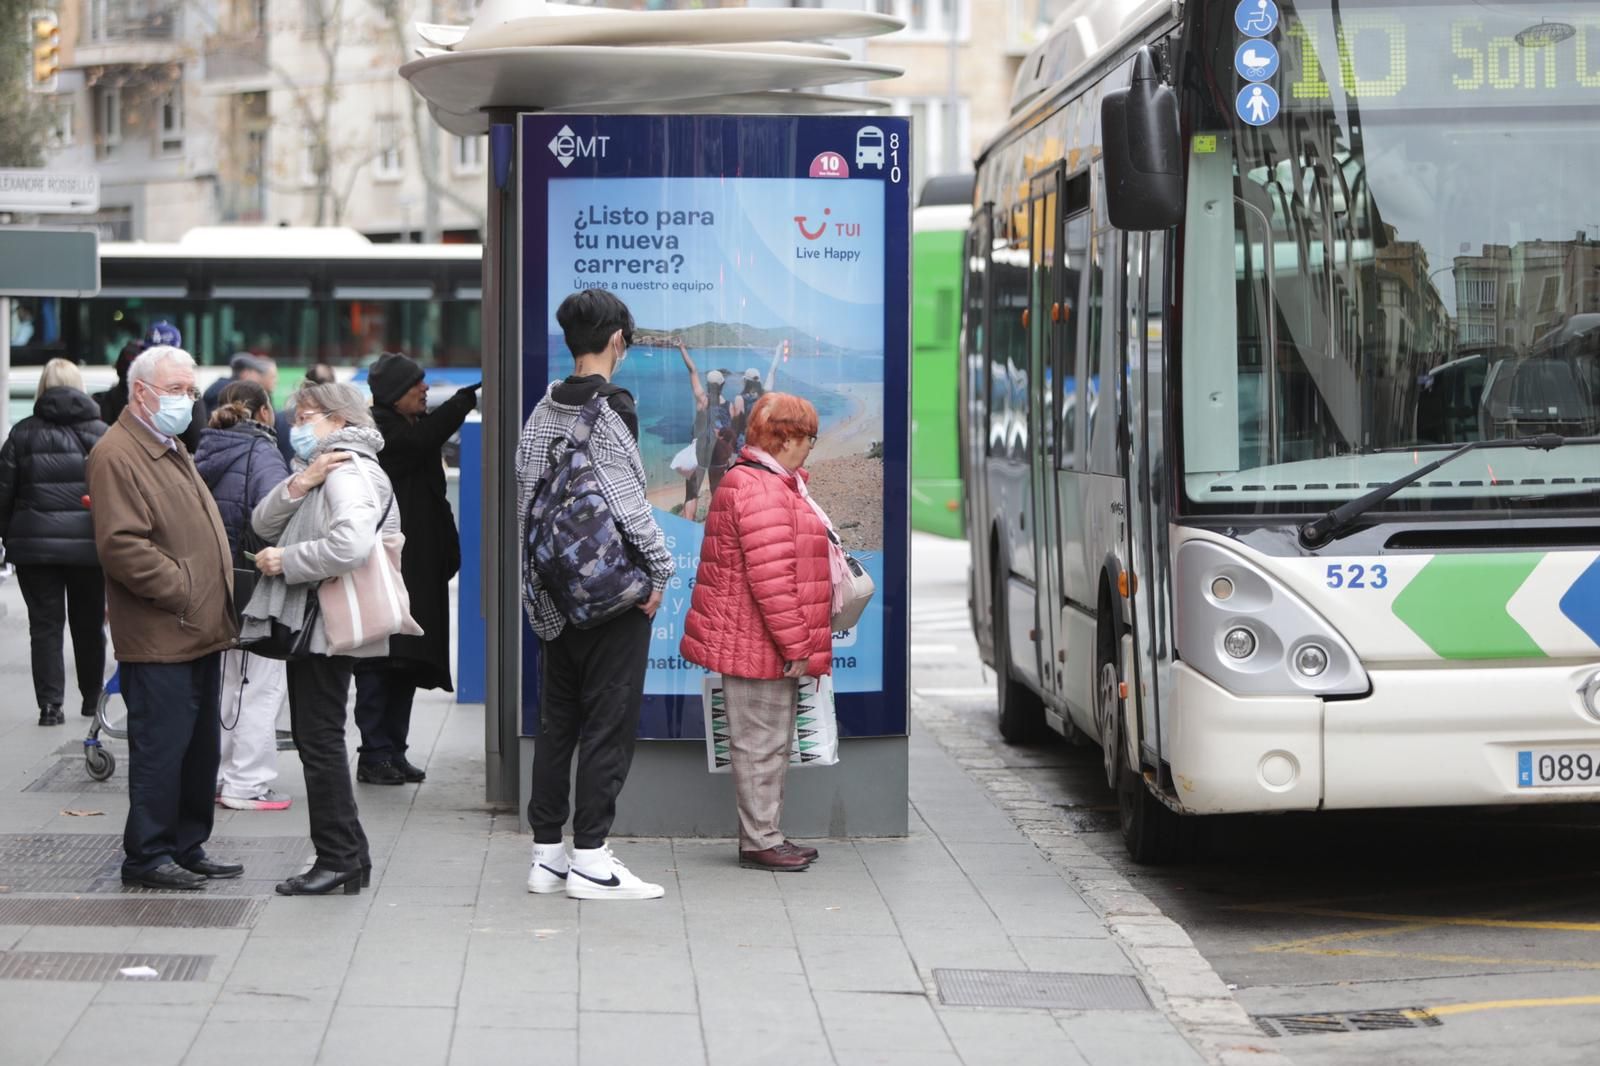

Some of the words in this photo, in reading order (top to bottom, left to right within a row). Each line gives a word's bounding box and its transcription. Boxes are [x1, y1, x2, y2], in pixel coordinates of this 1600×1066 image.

[1286, 12, 1406, 98] 10
[1452, 17, 1556, 90] Son
[820, 156, 840, 171] 10
[574, 204, 649, 231] ¿Listo
[656, 210, 715, 231] para
[835, 223, 861, 237] TUI
[573, 231, 599, 250] tu
[606, 233, 679, 250] nueva
[796, 246, 821, 259] Live
[824, 246, 861, 262] Happy
[574, 254, 685, 275] carrera?
[573, 276, 609, 290] Únete
[611, 281, 618, 290] a
[620, 279, 669, 291] nuestro
[672, 279, 714, 293] equipo
[1326, 563, 1389, 590] 523
[1538, 753, 1600, 782] 089
